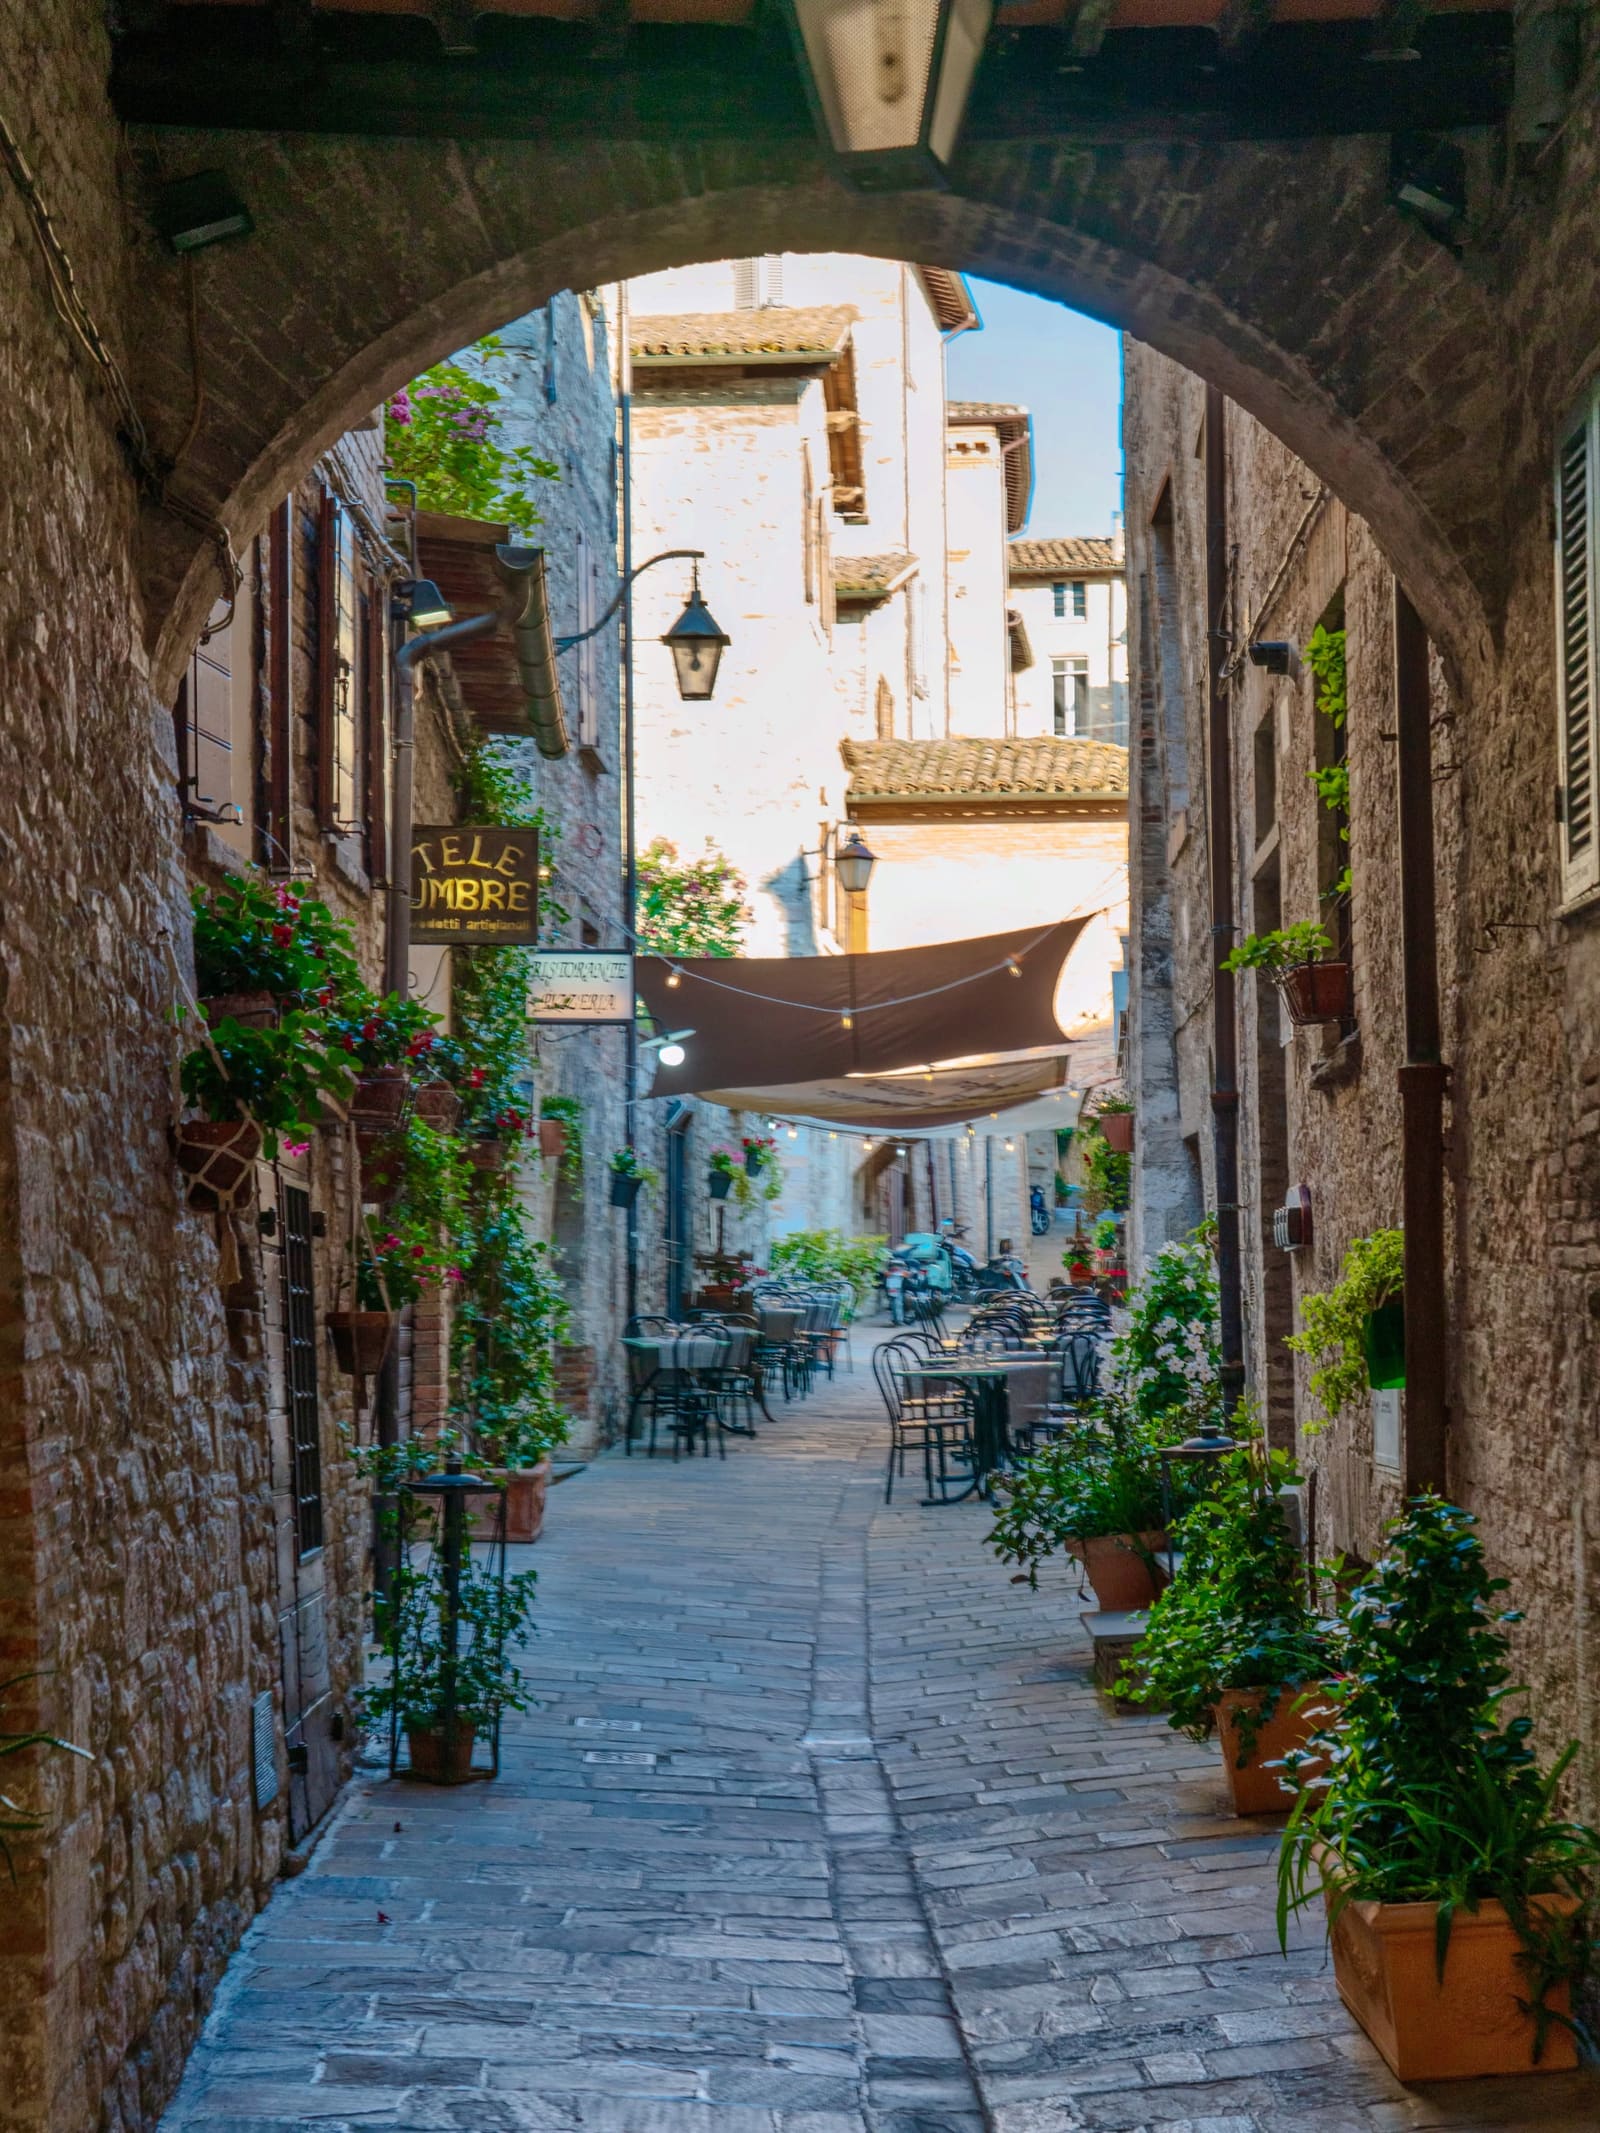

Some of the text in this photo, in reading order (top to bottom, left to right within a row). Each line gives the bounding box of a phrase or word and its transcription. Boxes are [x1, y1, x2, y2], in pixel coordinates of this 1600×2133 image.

[410, 834, 526, 877] TELE
[466, 918, 530, 933] artigianali
[530, 960, 628, 982] RISTORANTE
[543, 993, 616, 1013] PIZZERIA
